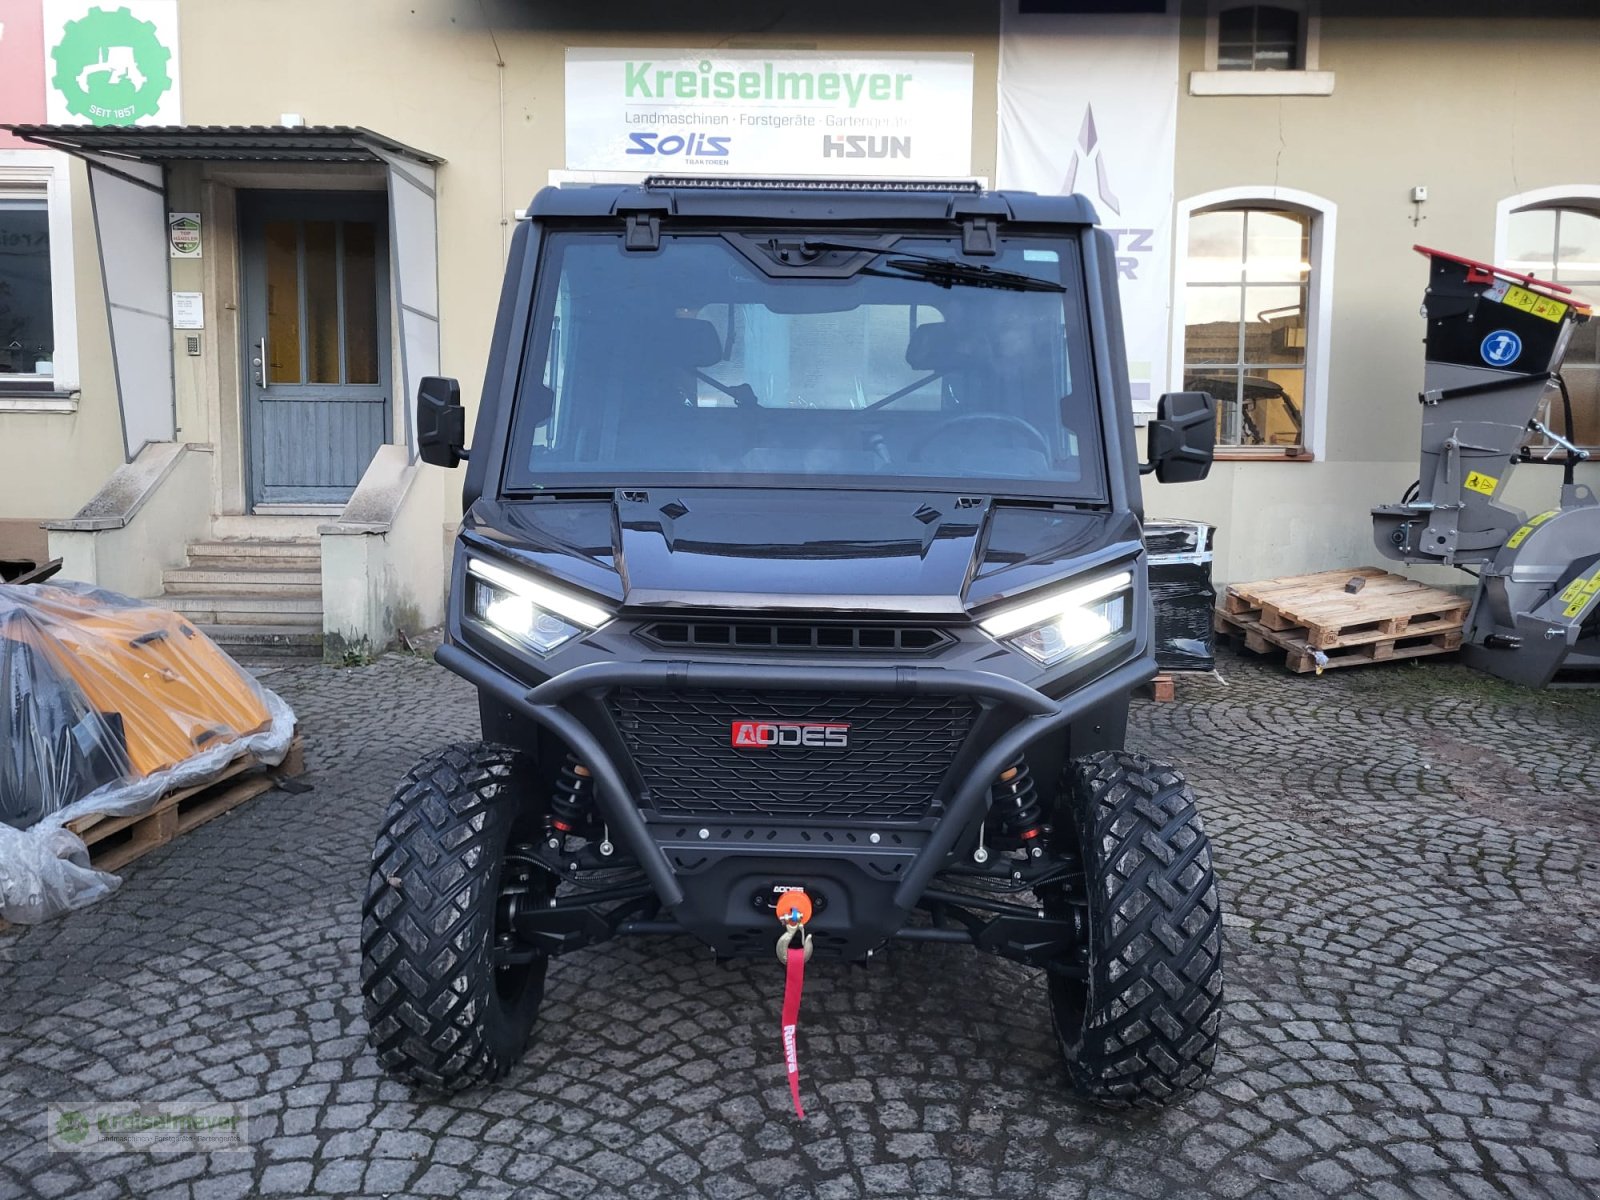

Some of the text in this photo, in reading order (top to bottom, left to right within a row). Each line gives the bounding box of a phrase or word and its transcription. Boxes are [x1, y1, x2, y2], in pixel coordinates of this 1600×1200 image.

[624, 60, 913, 108] Kreiselmeyer
[89, 104, 135, 119] SEIT 1857
[625, 111, 729, 124] Landmaschinen
[740, 113, 815, 128] Forstgeräte
[735, 724, 848, 747] AODES
